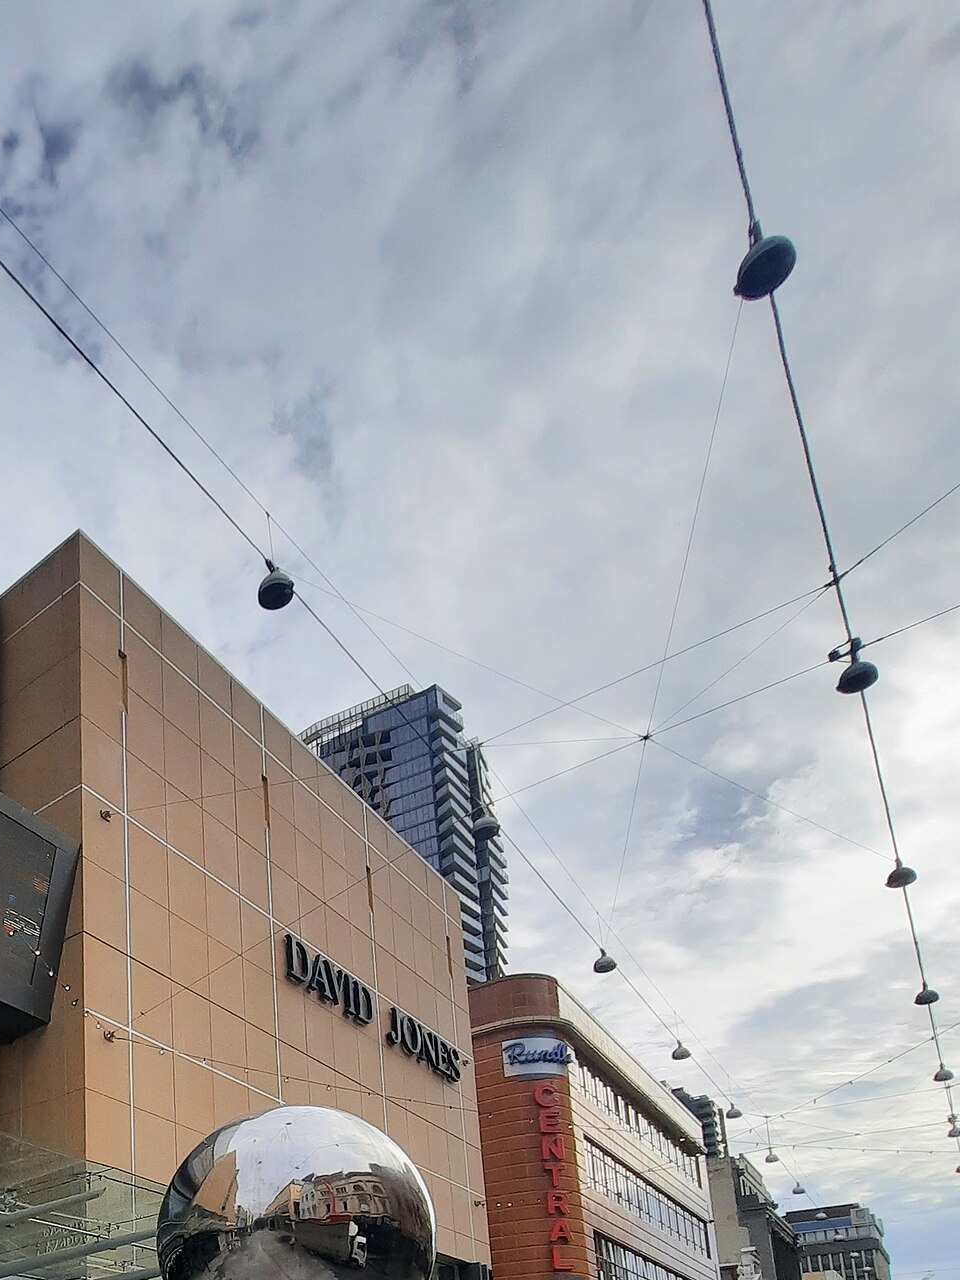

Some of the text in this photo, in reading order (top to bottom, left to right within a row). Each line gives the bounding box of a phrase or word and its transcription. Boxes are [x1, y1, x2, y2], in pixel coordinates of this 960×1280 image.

[284, 932, 461, 1083] DAVID JONES
[534, 1083, 575, 1271] CENTRAL
